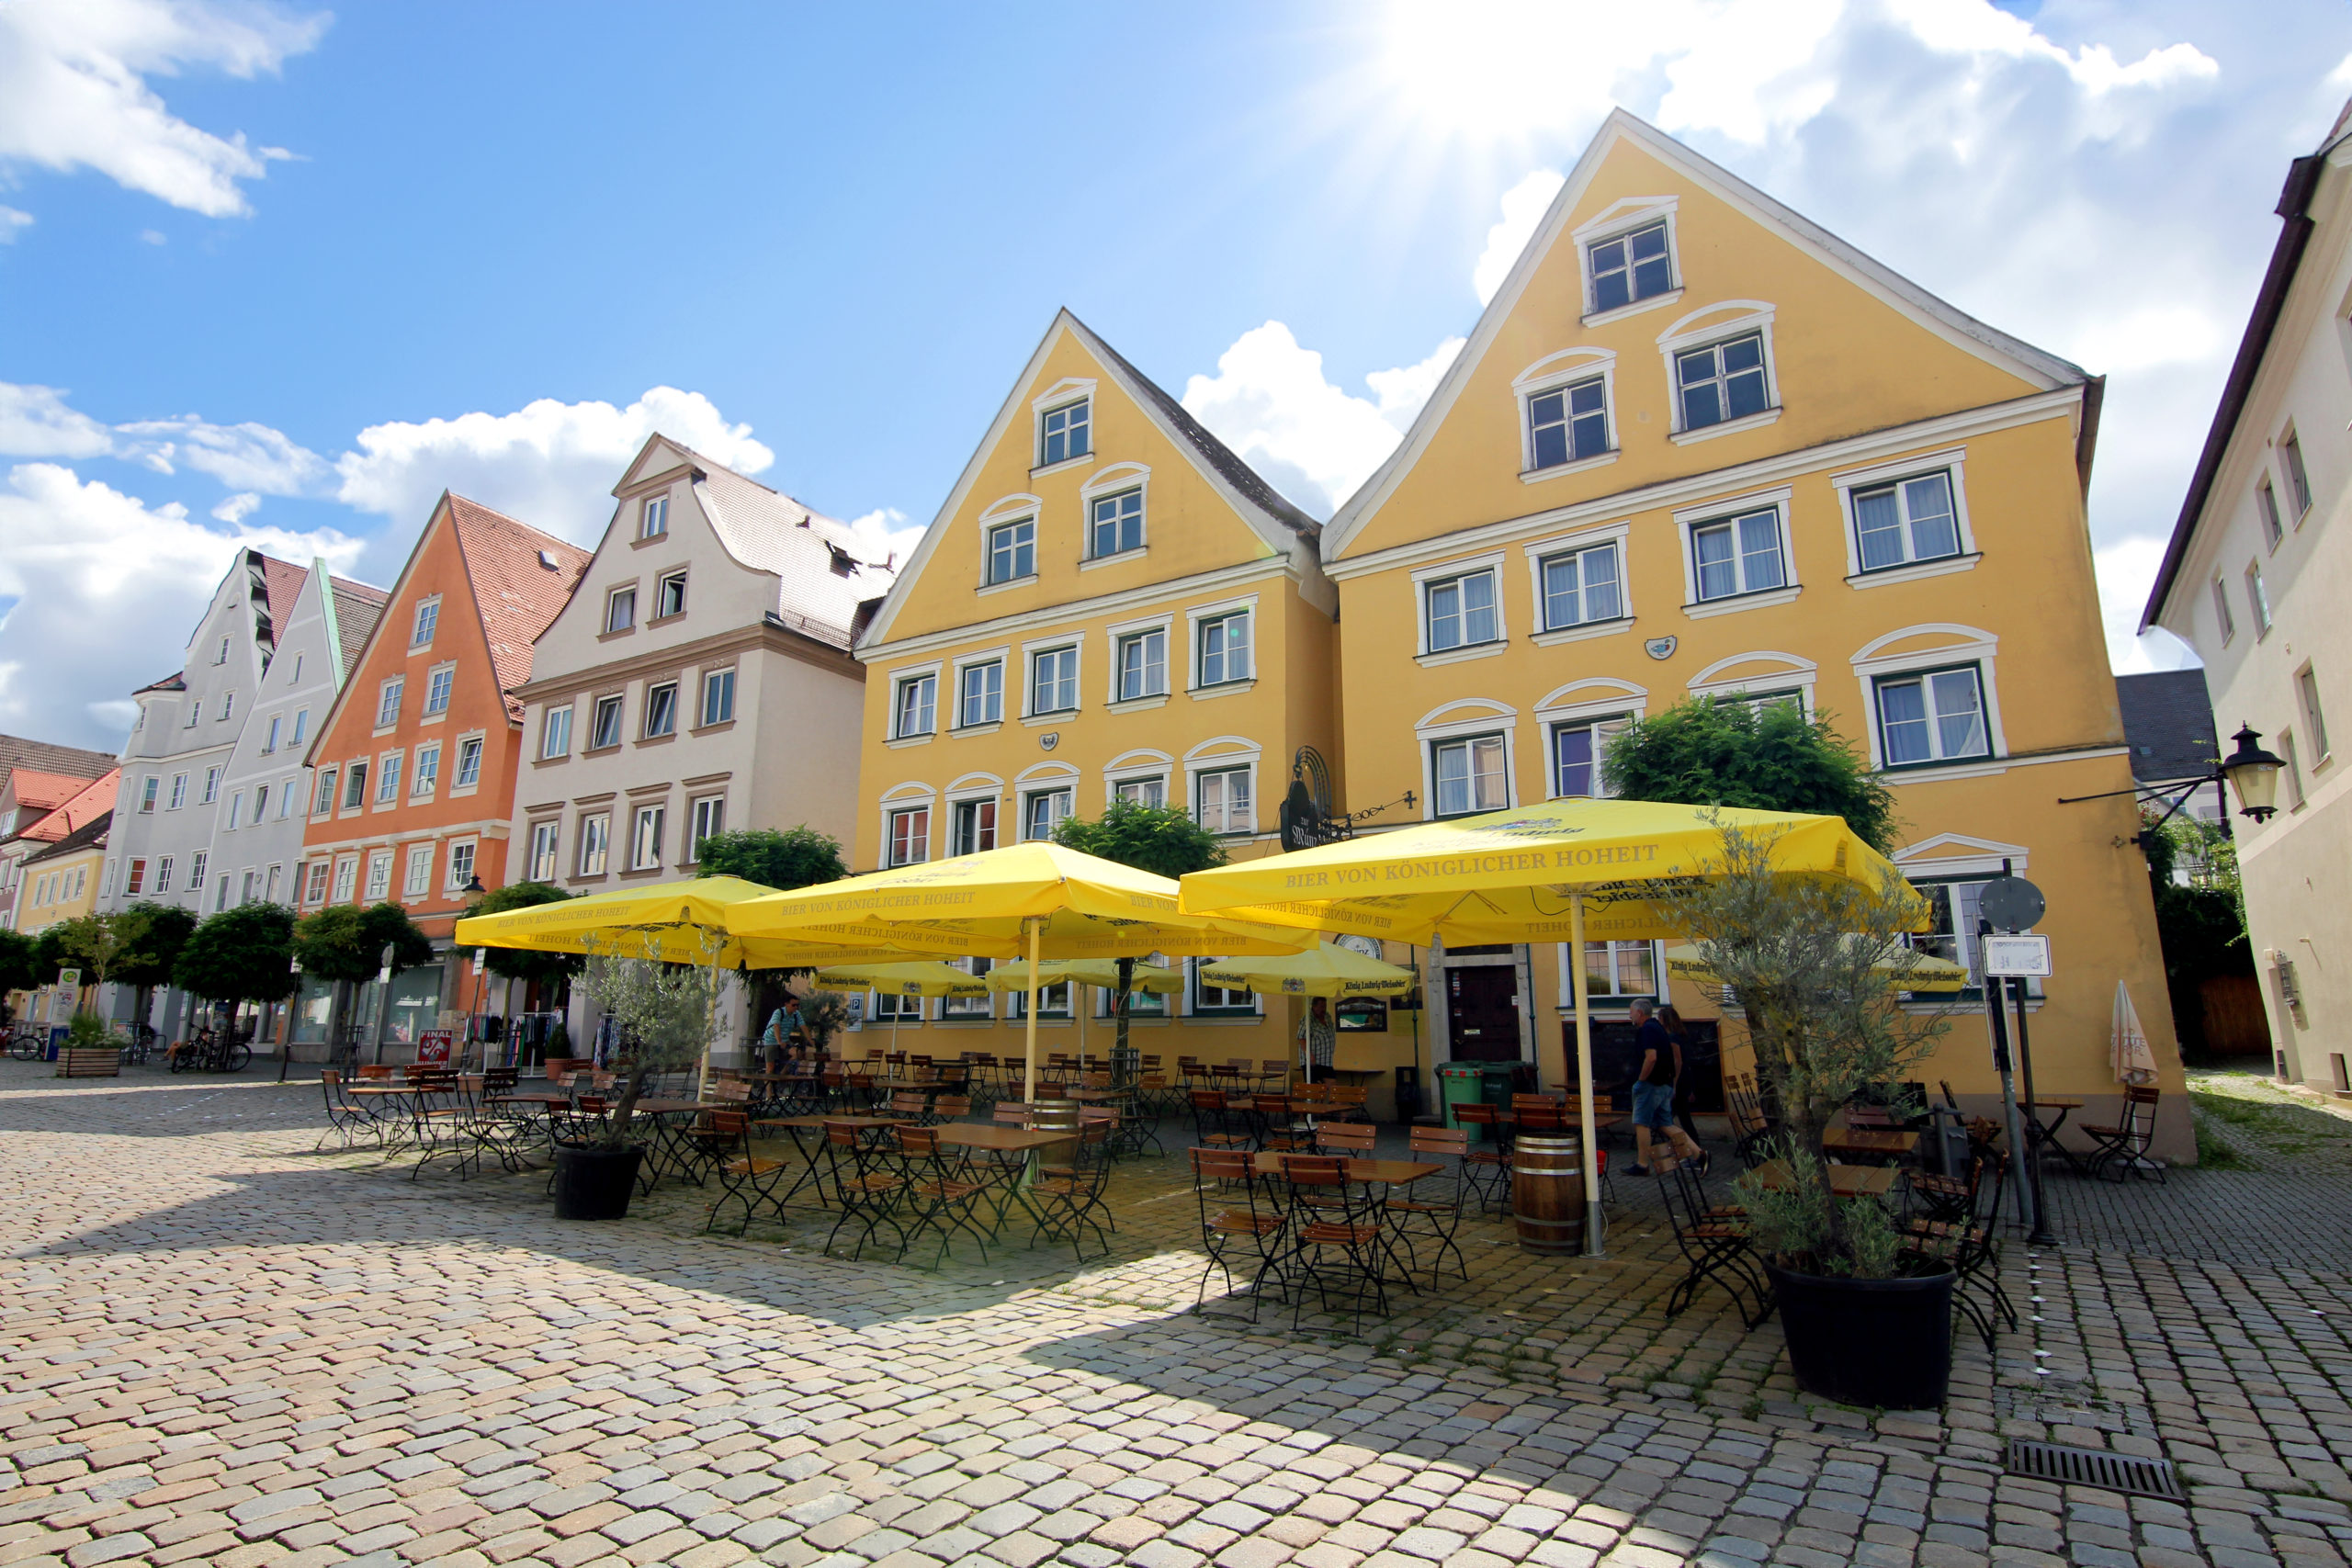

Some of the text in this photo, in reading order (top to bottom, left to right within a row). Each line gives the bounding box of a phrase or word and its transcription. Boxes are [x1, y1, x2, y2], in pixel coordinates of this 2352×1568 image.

[1285, 844, 1660, 888] BIER VON KÖNIGLICHER HOHEIT
[782, 891, 976, 917] BIER VON KÖNIGLICHER HOHEIT
[1130, 895, 1178, 912] BIER VON
[496, 905, 631, 929] BIER VON KÖNIGLICHER HOHEIT
[853, 999, 859, 1010] P
